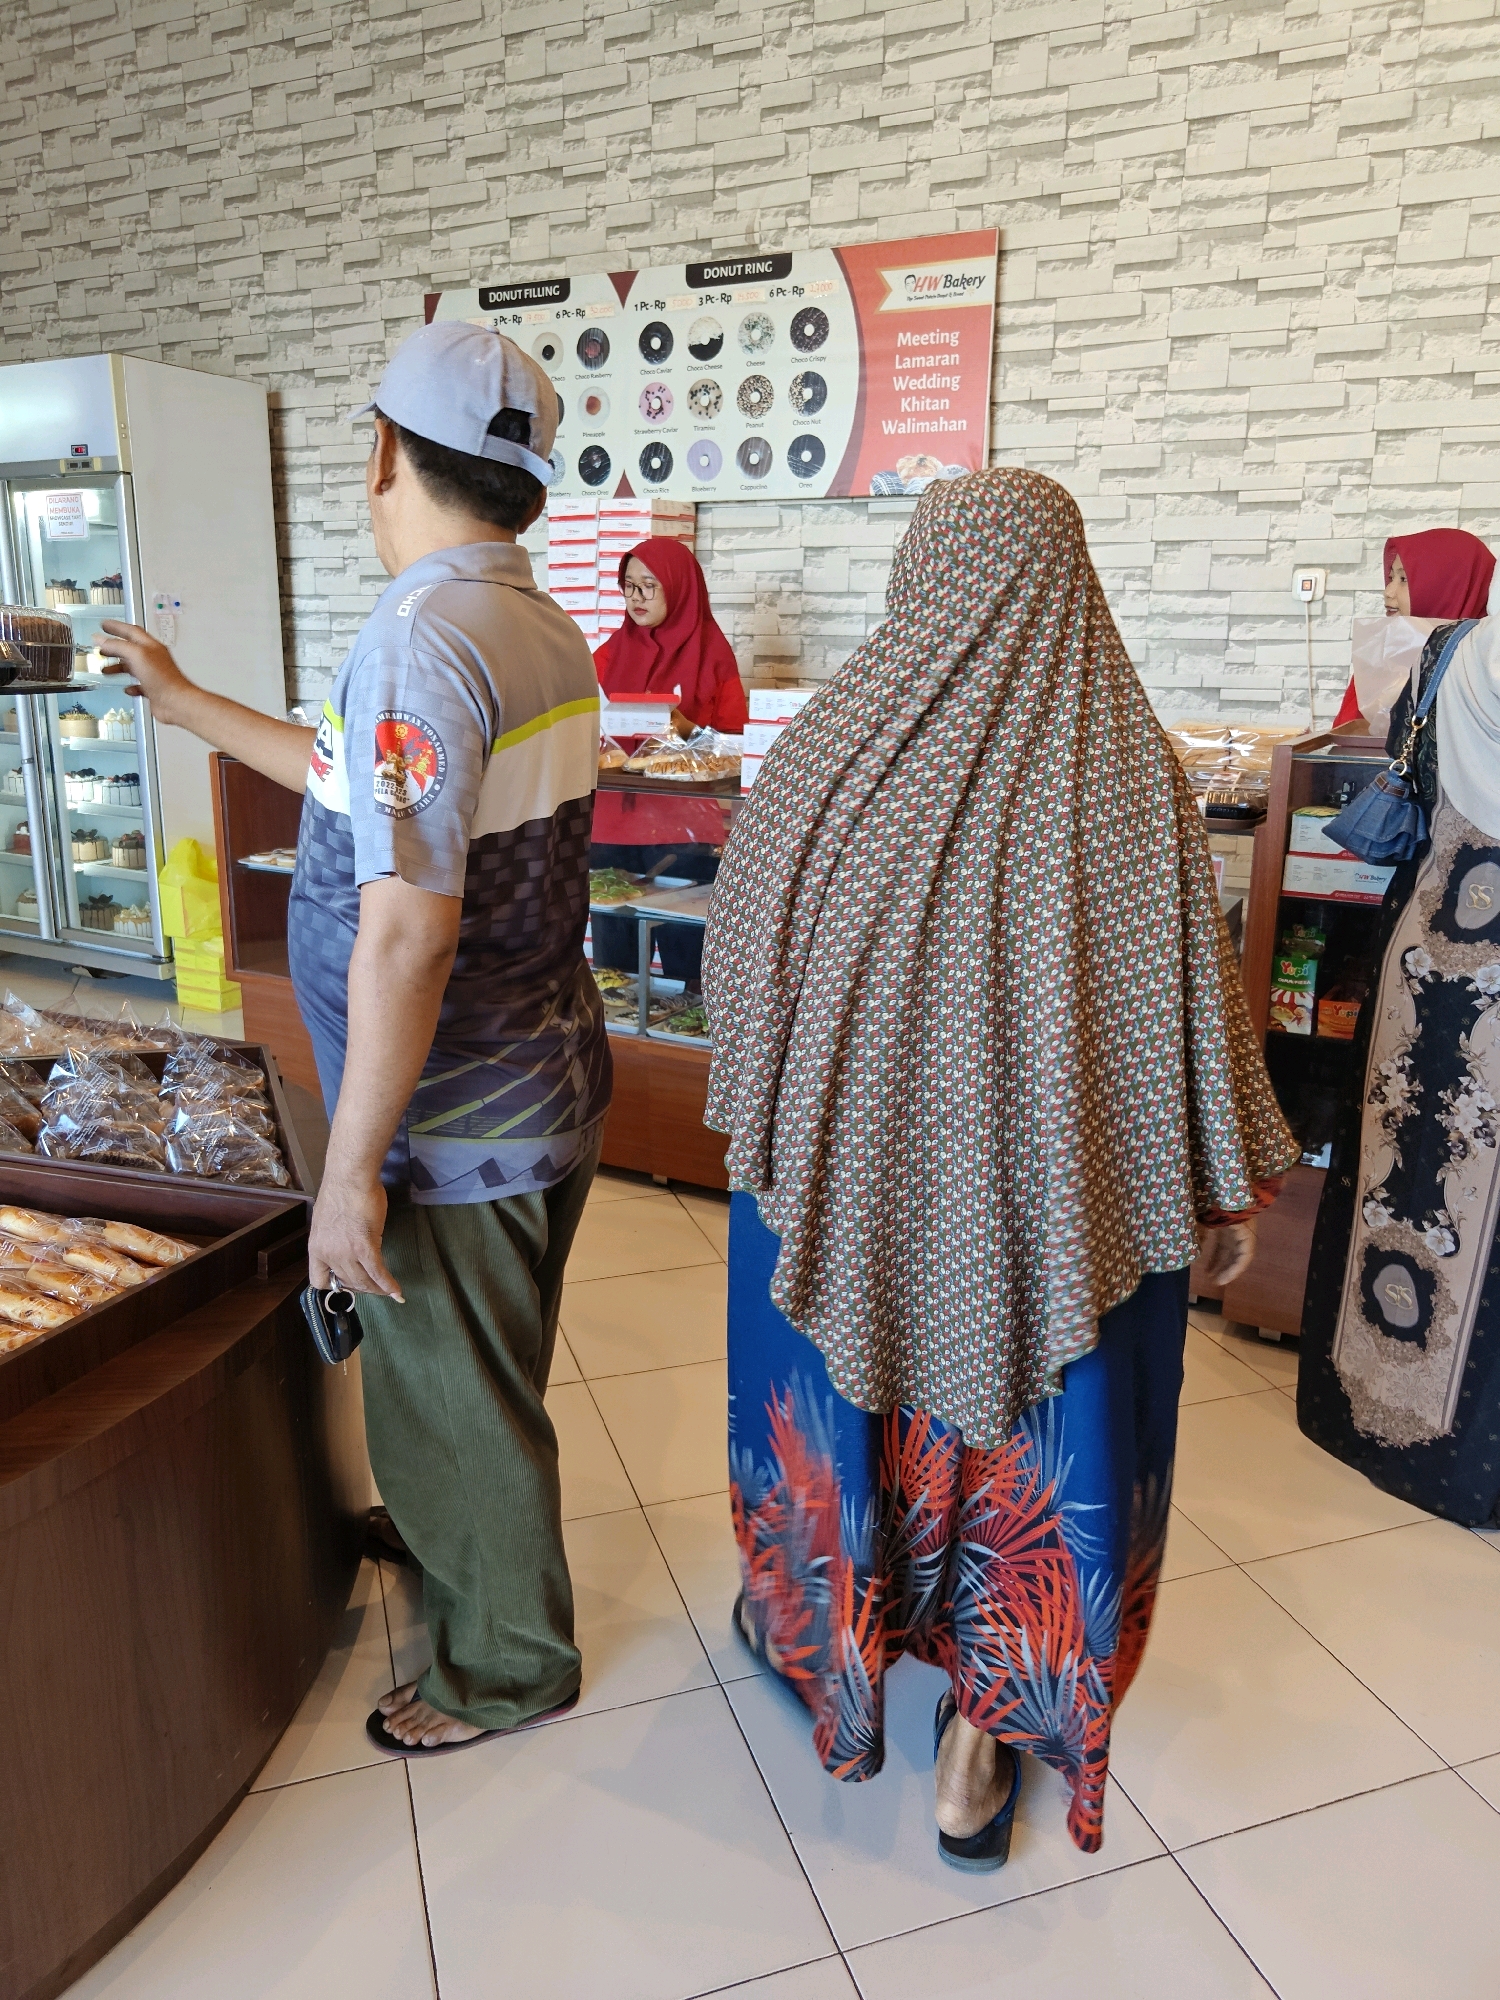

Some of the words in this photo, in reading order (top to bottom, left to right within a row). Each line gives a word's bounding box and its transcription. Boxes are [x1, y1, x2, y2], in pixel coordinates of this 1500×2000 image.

[704, 264, 743, 280] DONUT
[744, 261, 773, 275] RING
[913, 274, 943, 292] HW
[943, 273, 986, 290] Bakery
[488, 289, 522, 303] DONUT
[523, 285, 560, 299] FILLING
[698, 297, 704, 306] 3
[769, 289, 775, 298] 6
[493, 318, 499, 327] 3
[555, 311, 561, 319] 6
[897, 329, 960, 347] Meeting
[895, 354, 960, 369] Lamaran
[892, 373, 961, 391] Wedding
[901, 395, 950, 412] Khitan
[881, 416, 967, 435] Walimahan
[49, 496, 79, 504] DILARANG
[50, 506, 80, 514] MEMBUKA
[1281, 960, 1310, 977] Yupi
[1333, 1004, 1359, 1018] Yupi
